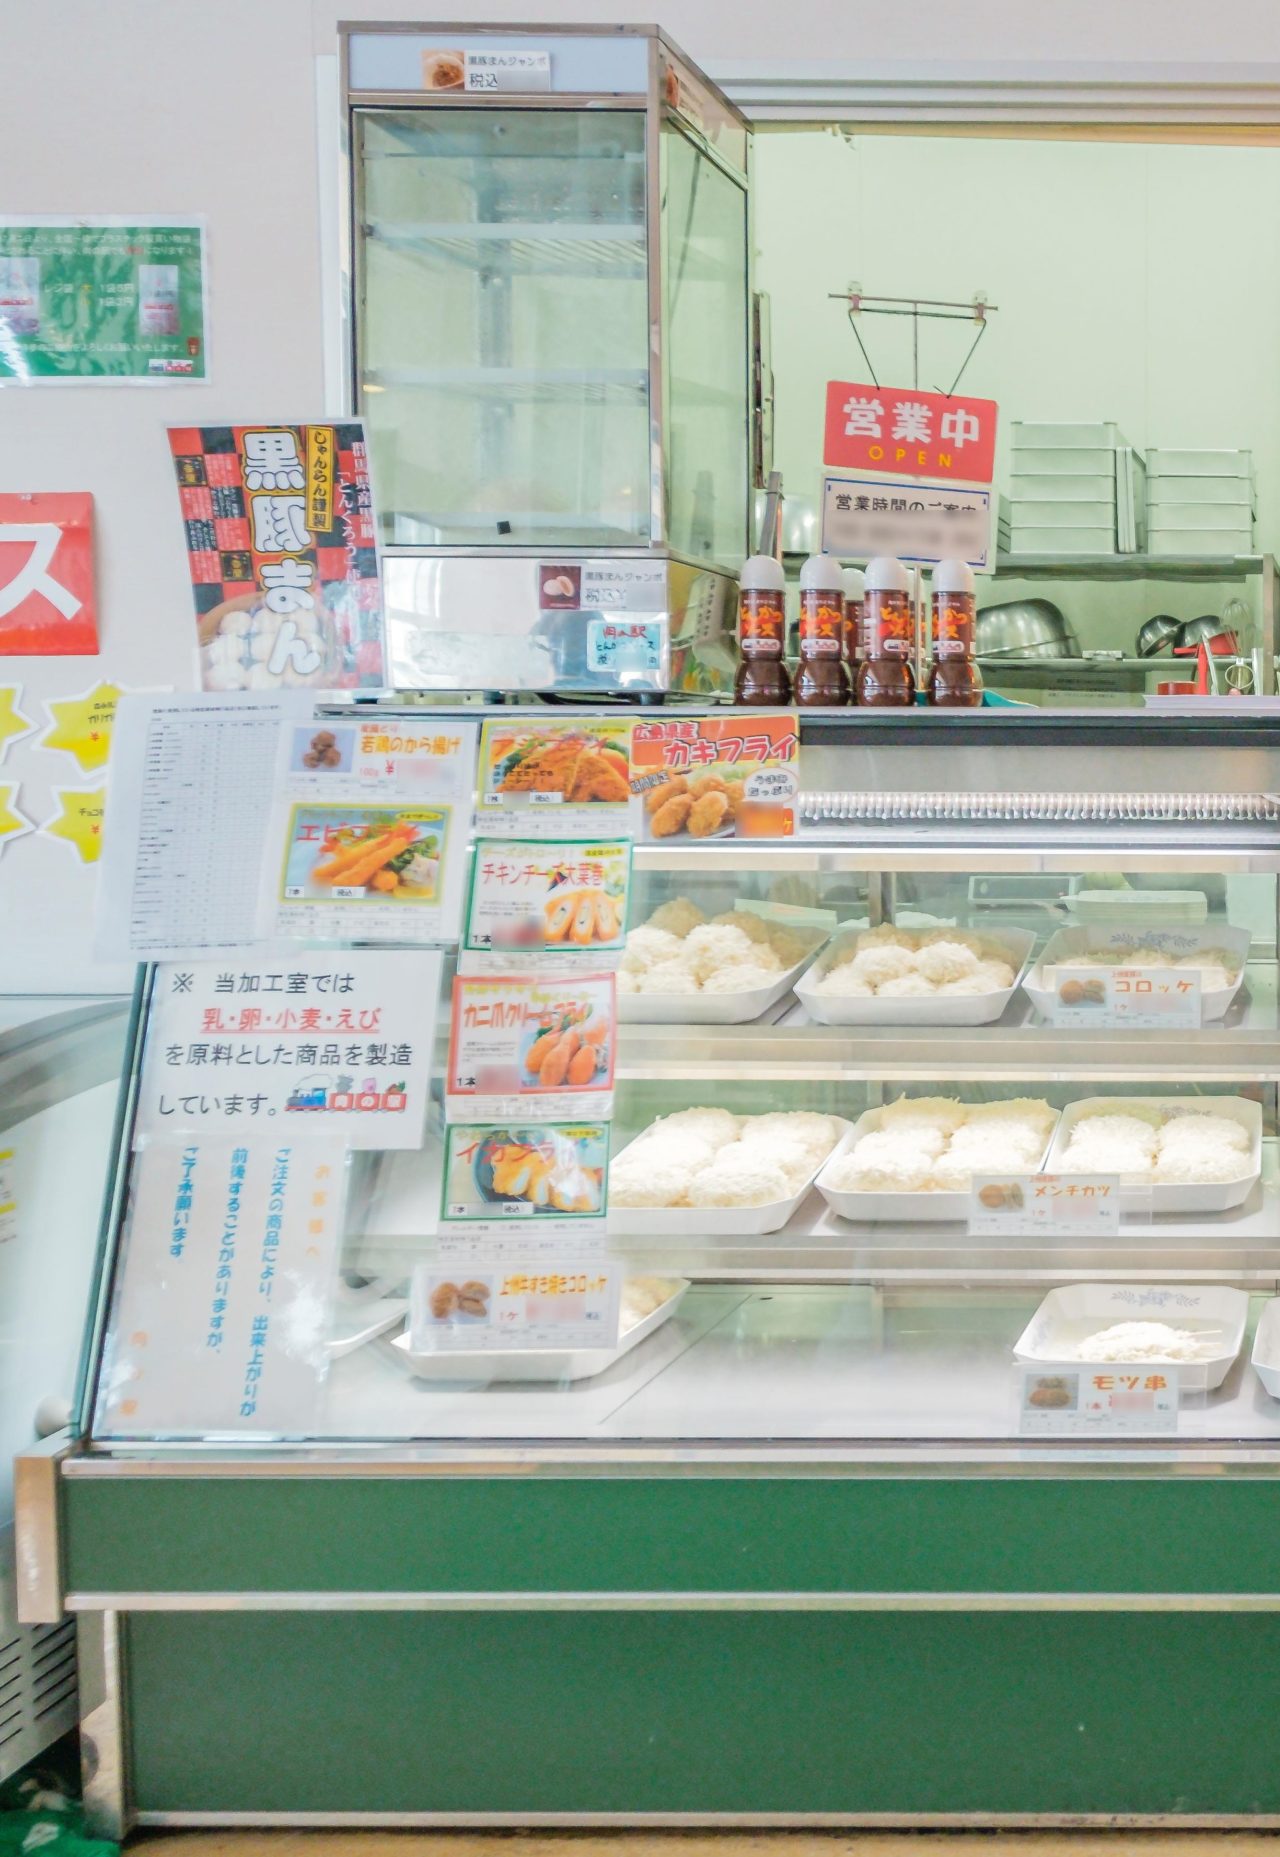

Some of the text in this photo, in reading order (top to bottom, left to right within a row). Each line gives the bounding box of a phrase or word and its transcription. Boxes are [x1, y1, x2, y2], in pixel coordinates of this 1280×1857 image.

[470, 73, 498, 88] 税込
[842, 397, 980, 448] 営業中
[868, 445, 953, 467] OPEN
[243, 430, 321, 675] 黒豚まん
[663, 733, 798, 767] カキフライ
[214, 972, 355, 994] 当加工室では
[1115, 980, 1194, 993] コロッケ
[202, 1007, 381, 1031] 乳・卵・小麦・えび
[165, 1043, 413, 1067] を原料とした商品を製造
[158, 1095, 277, 1117] しています。
[1035, 1185, 1111, 1197] メンチカツ
[1092, 1375, 1168, 1391] モツ串
